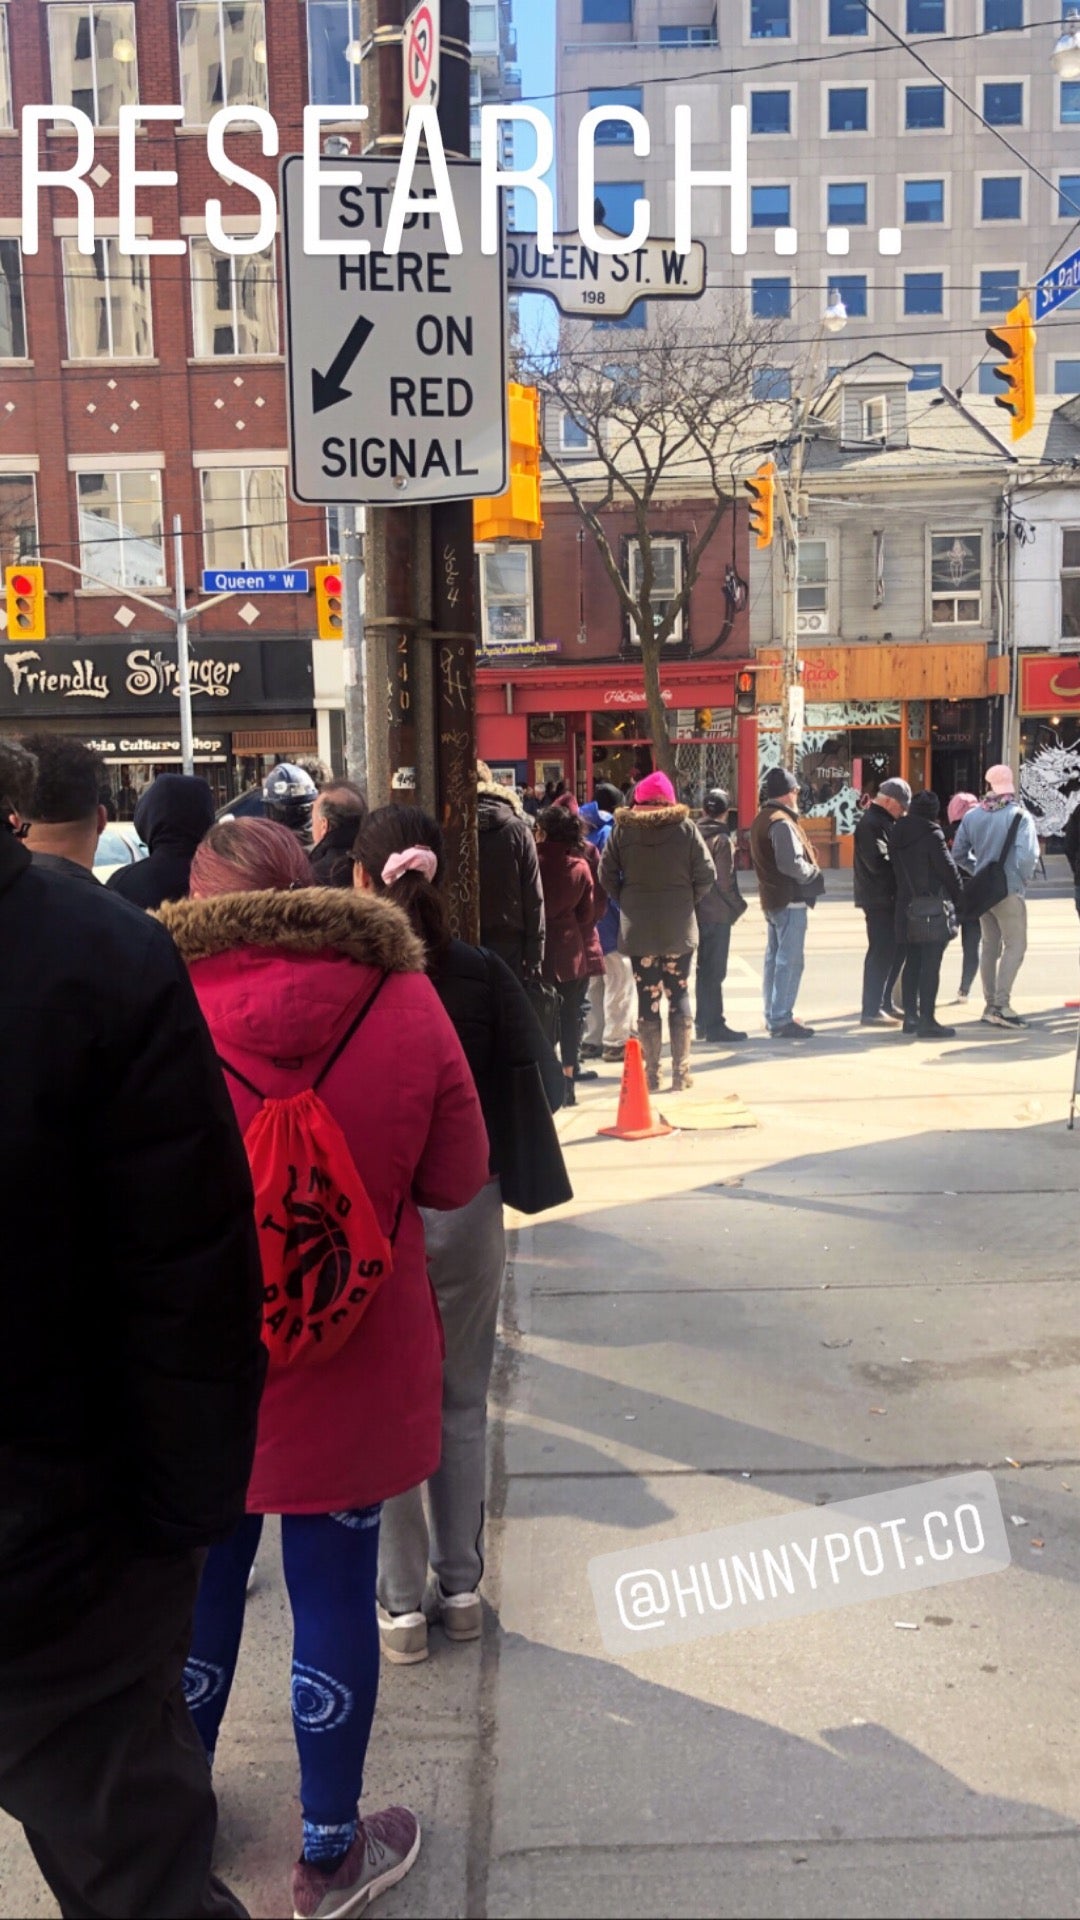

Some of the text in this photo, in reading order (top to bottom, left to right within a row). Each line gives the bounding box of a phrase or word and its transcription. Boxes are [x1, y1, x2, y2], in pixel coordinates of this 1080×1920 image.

[339, 250, 452, 293] HERE
[507, 243, 688, 286] QUEEN ST. W.
[581, 290, 605, 305] 198
[416, 314, 473, 357] ON
[389, 376, 473, 418] RED
[321, 436, 479, 479] SIGNAL
[214, 574, 265, 590] Queen
[283, 574, 295, 588] W
[4, 649, 241, 698] Friendly Strnger
[119, 738, 180, 751] Culture
